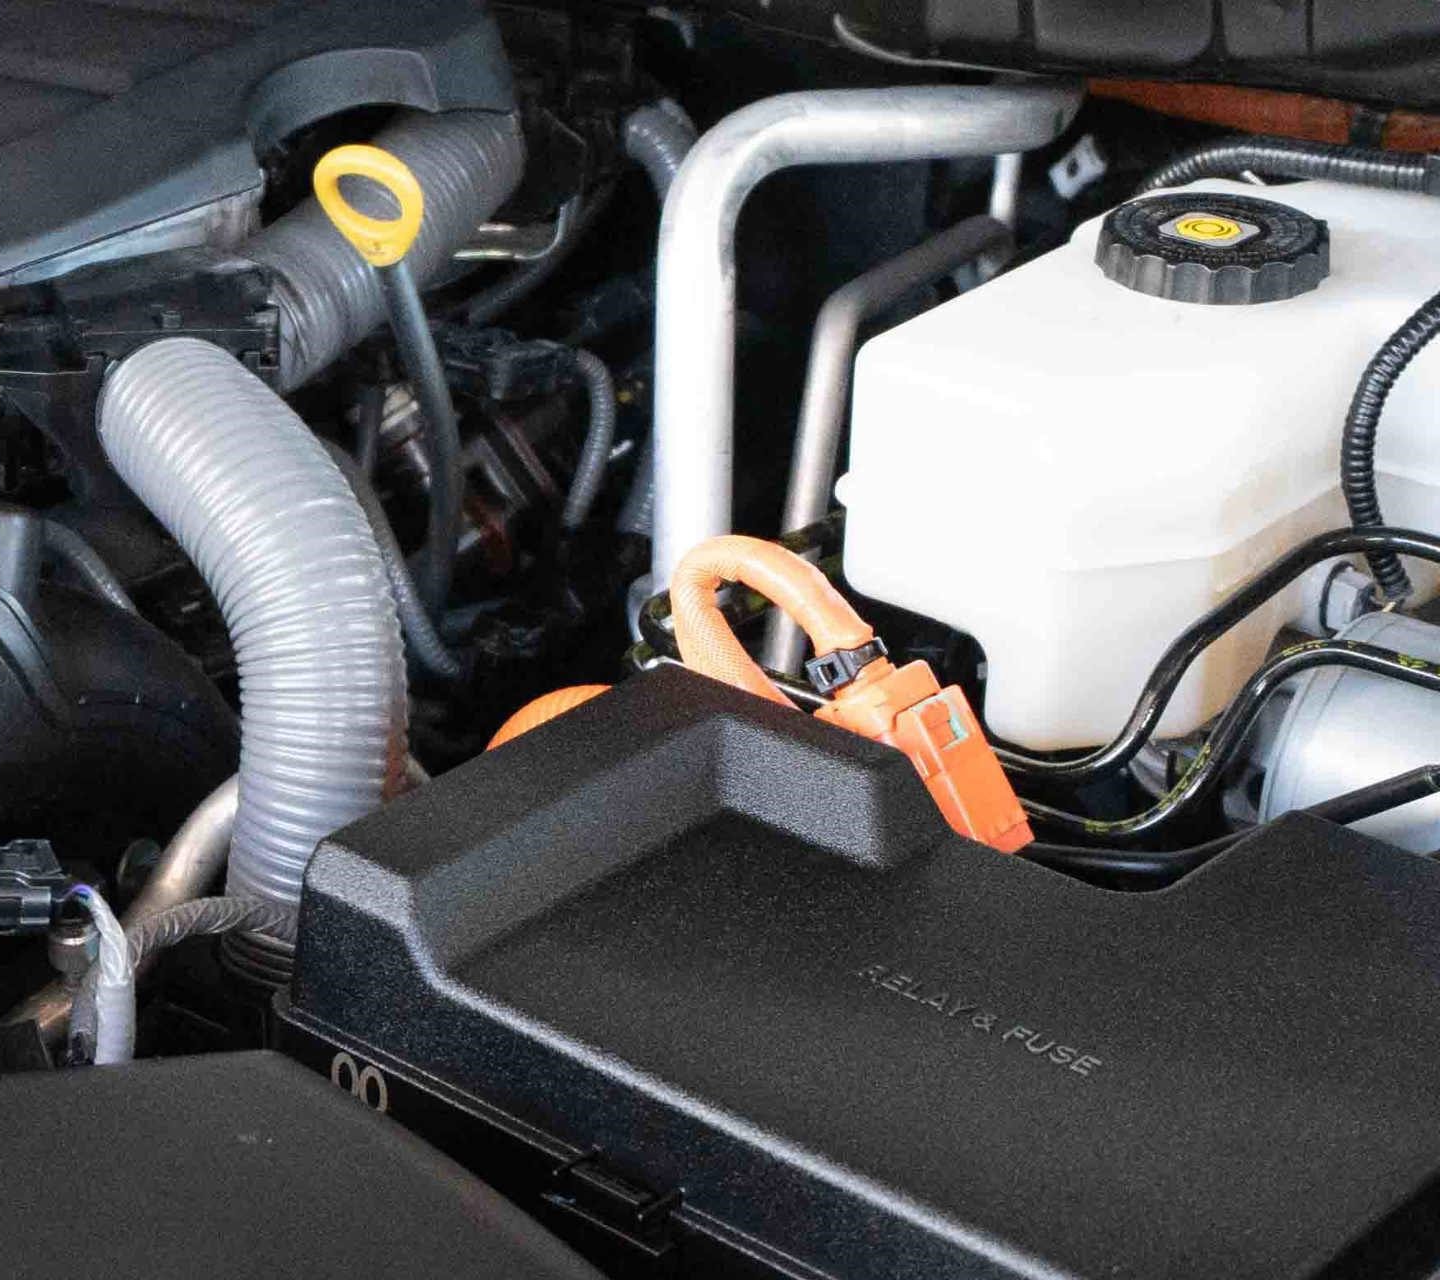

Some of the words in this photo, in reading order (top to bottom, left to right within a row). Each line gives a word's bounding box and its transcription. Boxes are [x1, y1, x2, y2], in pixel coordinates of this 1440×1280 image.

[857, 964, 977, 1017] RELAY
[971, 1013, 998, 1033] &
[1002, 1025, 1103, 1077] FUSE
